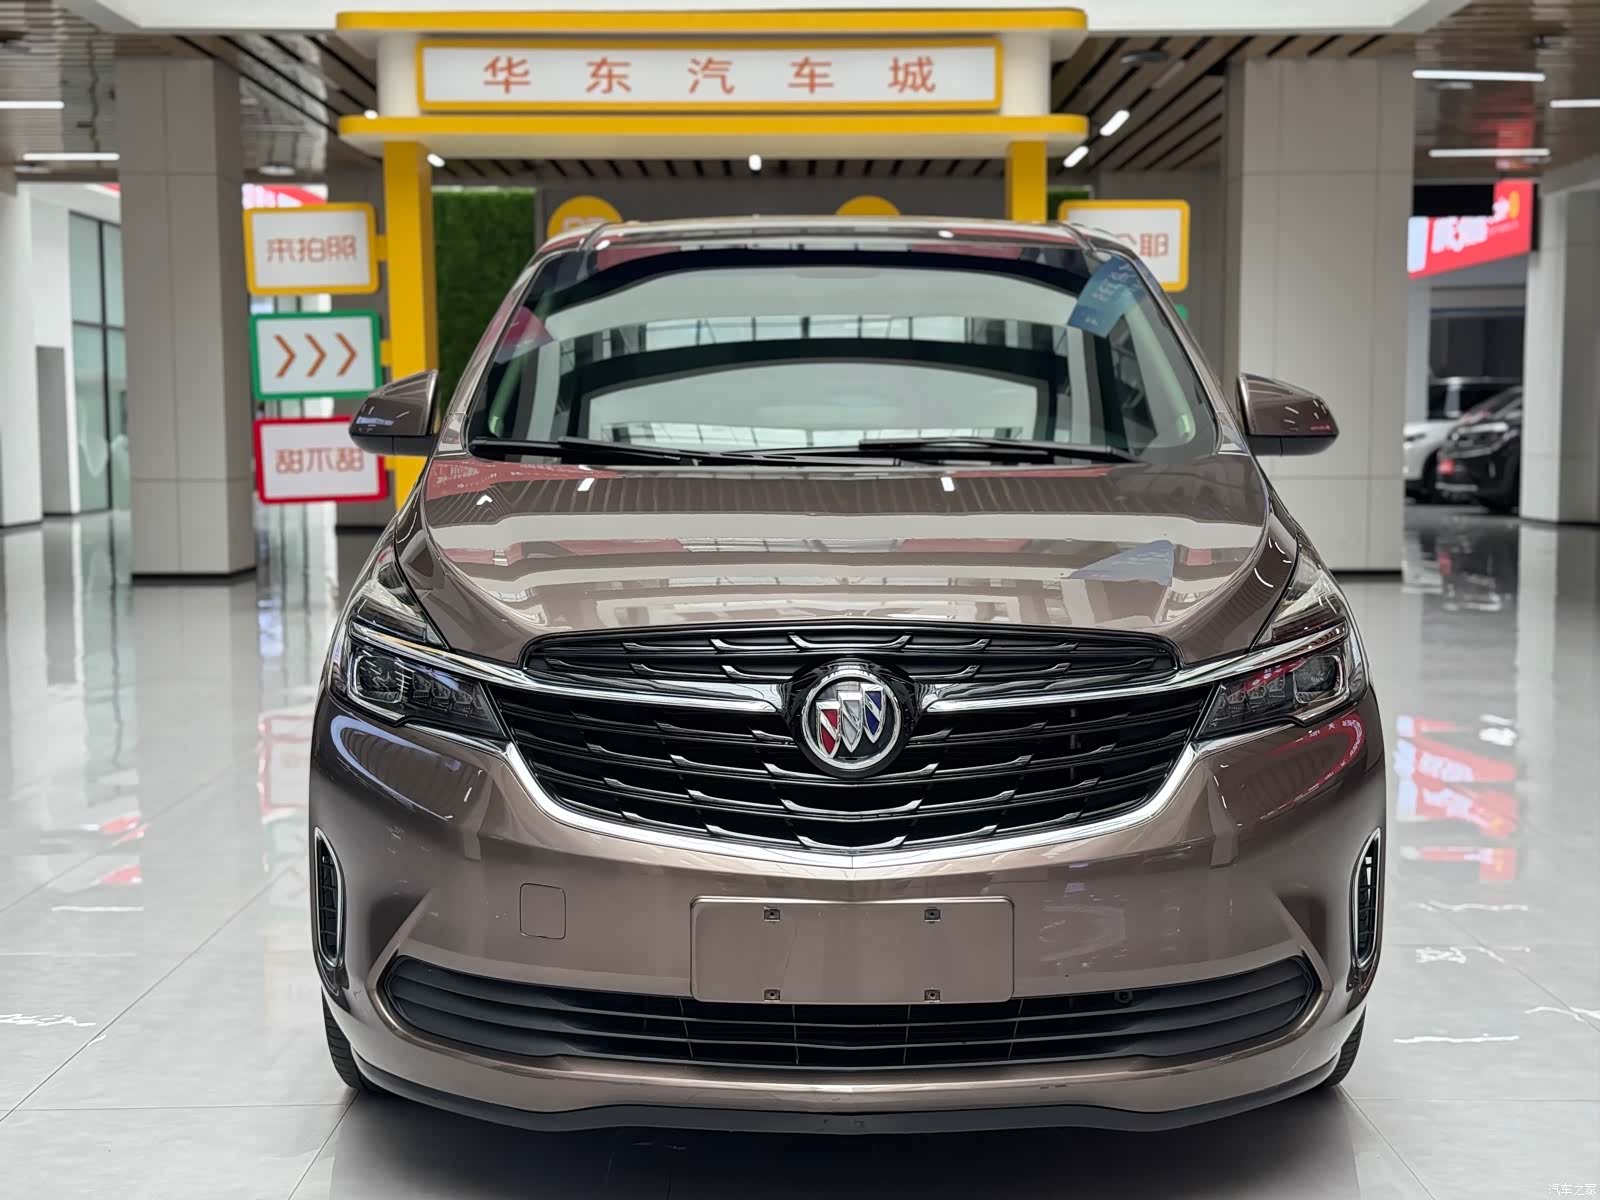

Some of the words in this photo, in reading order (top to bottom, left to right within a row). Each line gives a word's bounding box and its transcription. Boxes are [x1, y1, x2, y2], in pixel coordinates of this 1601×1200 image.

[483, 56, 936, 94] 华东汽车城
